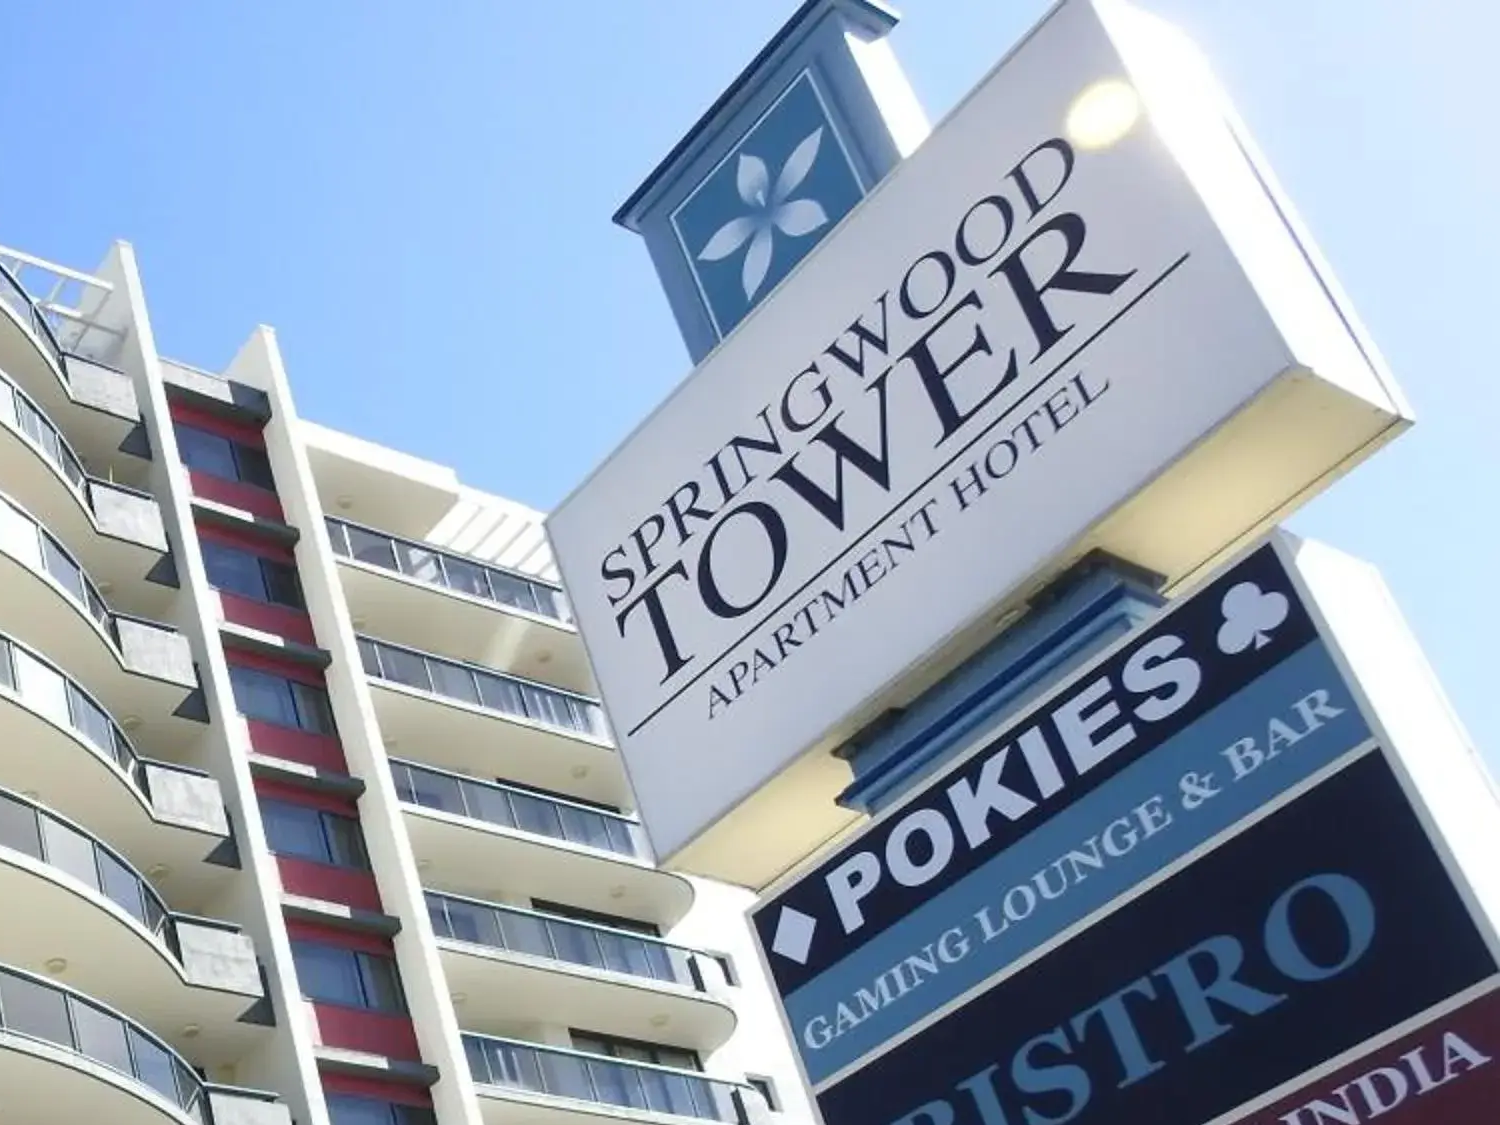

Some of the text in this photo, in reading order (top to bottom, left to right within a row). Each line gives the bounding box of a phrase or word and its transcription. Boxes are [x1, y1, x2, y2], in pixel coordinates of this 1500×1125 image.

[600, 136, 1077, 609] SPRINGWOOD
[614, 210, 1138, 687] TOWER
[705, 371, 1112, 721] APARTMENT HOTEL
[802, 683, 1348, 1051] GAMING LOUNGE & BAR
[823, 632, 1203, 935] POKIES
